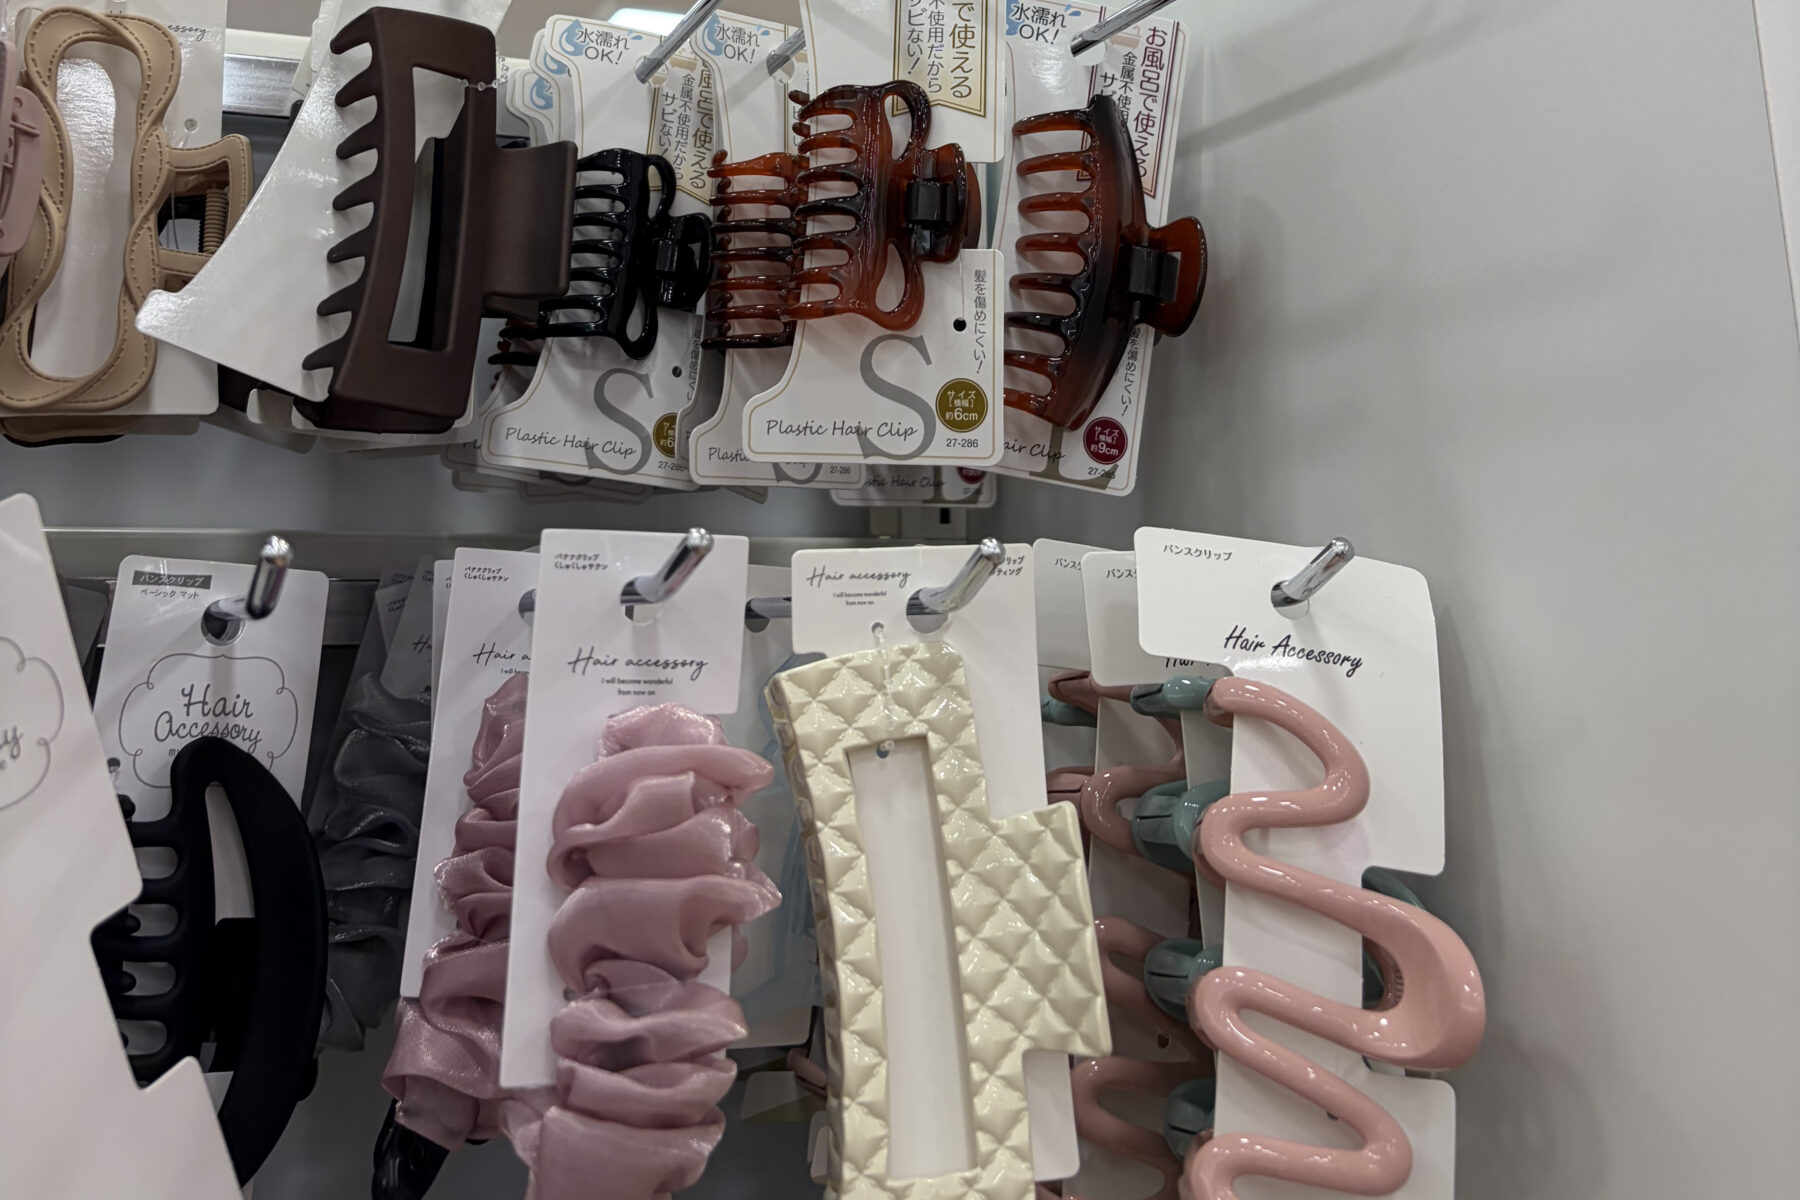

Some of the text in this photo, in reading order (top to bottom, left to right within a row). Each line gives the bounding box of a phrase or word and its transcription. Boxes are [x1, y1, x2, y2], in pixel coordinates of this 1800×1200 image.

[1011, 2, 1067, 29] 水濡れ
[576, 27, 630, 51] 水濡れ
[715, 22, 761, 48] 水濡れ
[1019, 24, 1060, 45] OK!
[584, 48, 623, 66] OK!
[723, 44, 756, 65] OK!
[860, 334, 937, 460] S
[946, 390, 977, 400] サイズ
[584, 367, 654, 476] S
[766, 419, 919, 442] Plastic Hair Clip
[505, 426, 637, 459] Plastic Hair Clip
[945, 438, 979, 448] 27-286
[1003, 440, 1066, 463] air Clip
[708, 446, 749, 463] Plasti
[806, 565, 912, 588] Hair accessory
[472, 642, 515, 667] Hair
[1224, 624, 1363, 678] Hair Accessory
[567, 646, 709, 682] Hair accessory
[617, 688, 632, 696] from
[643, 677, 673, 685] wonderful
[181, 683, 254, 719] Hair
[154, 711, 263, 755] Accessory
